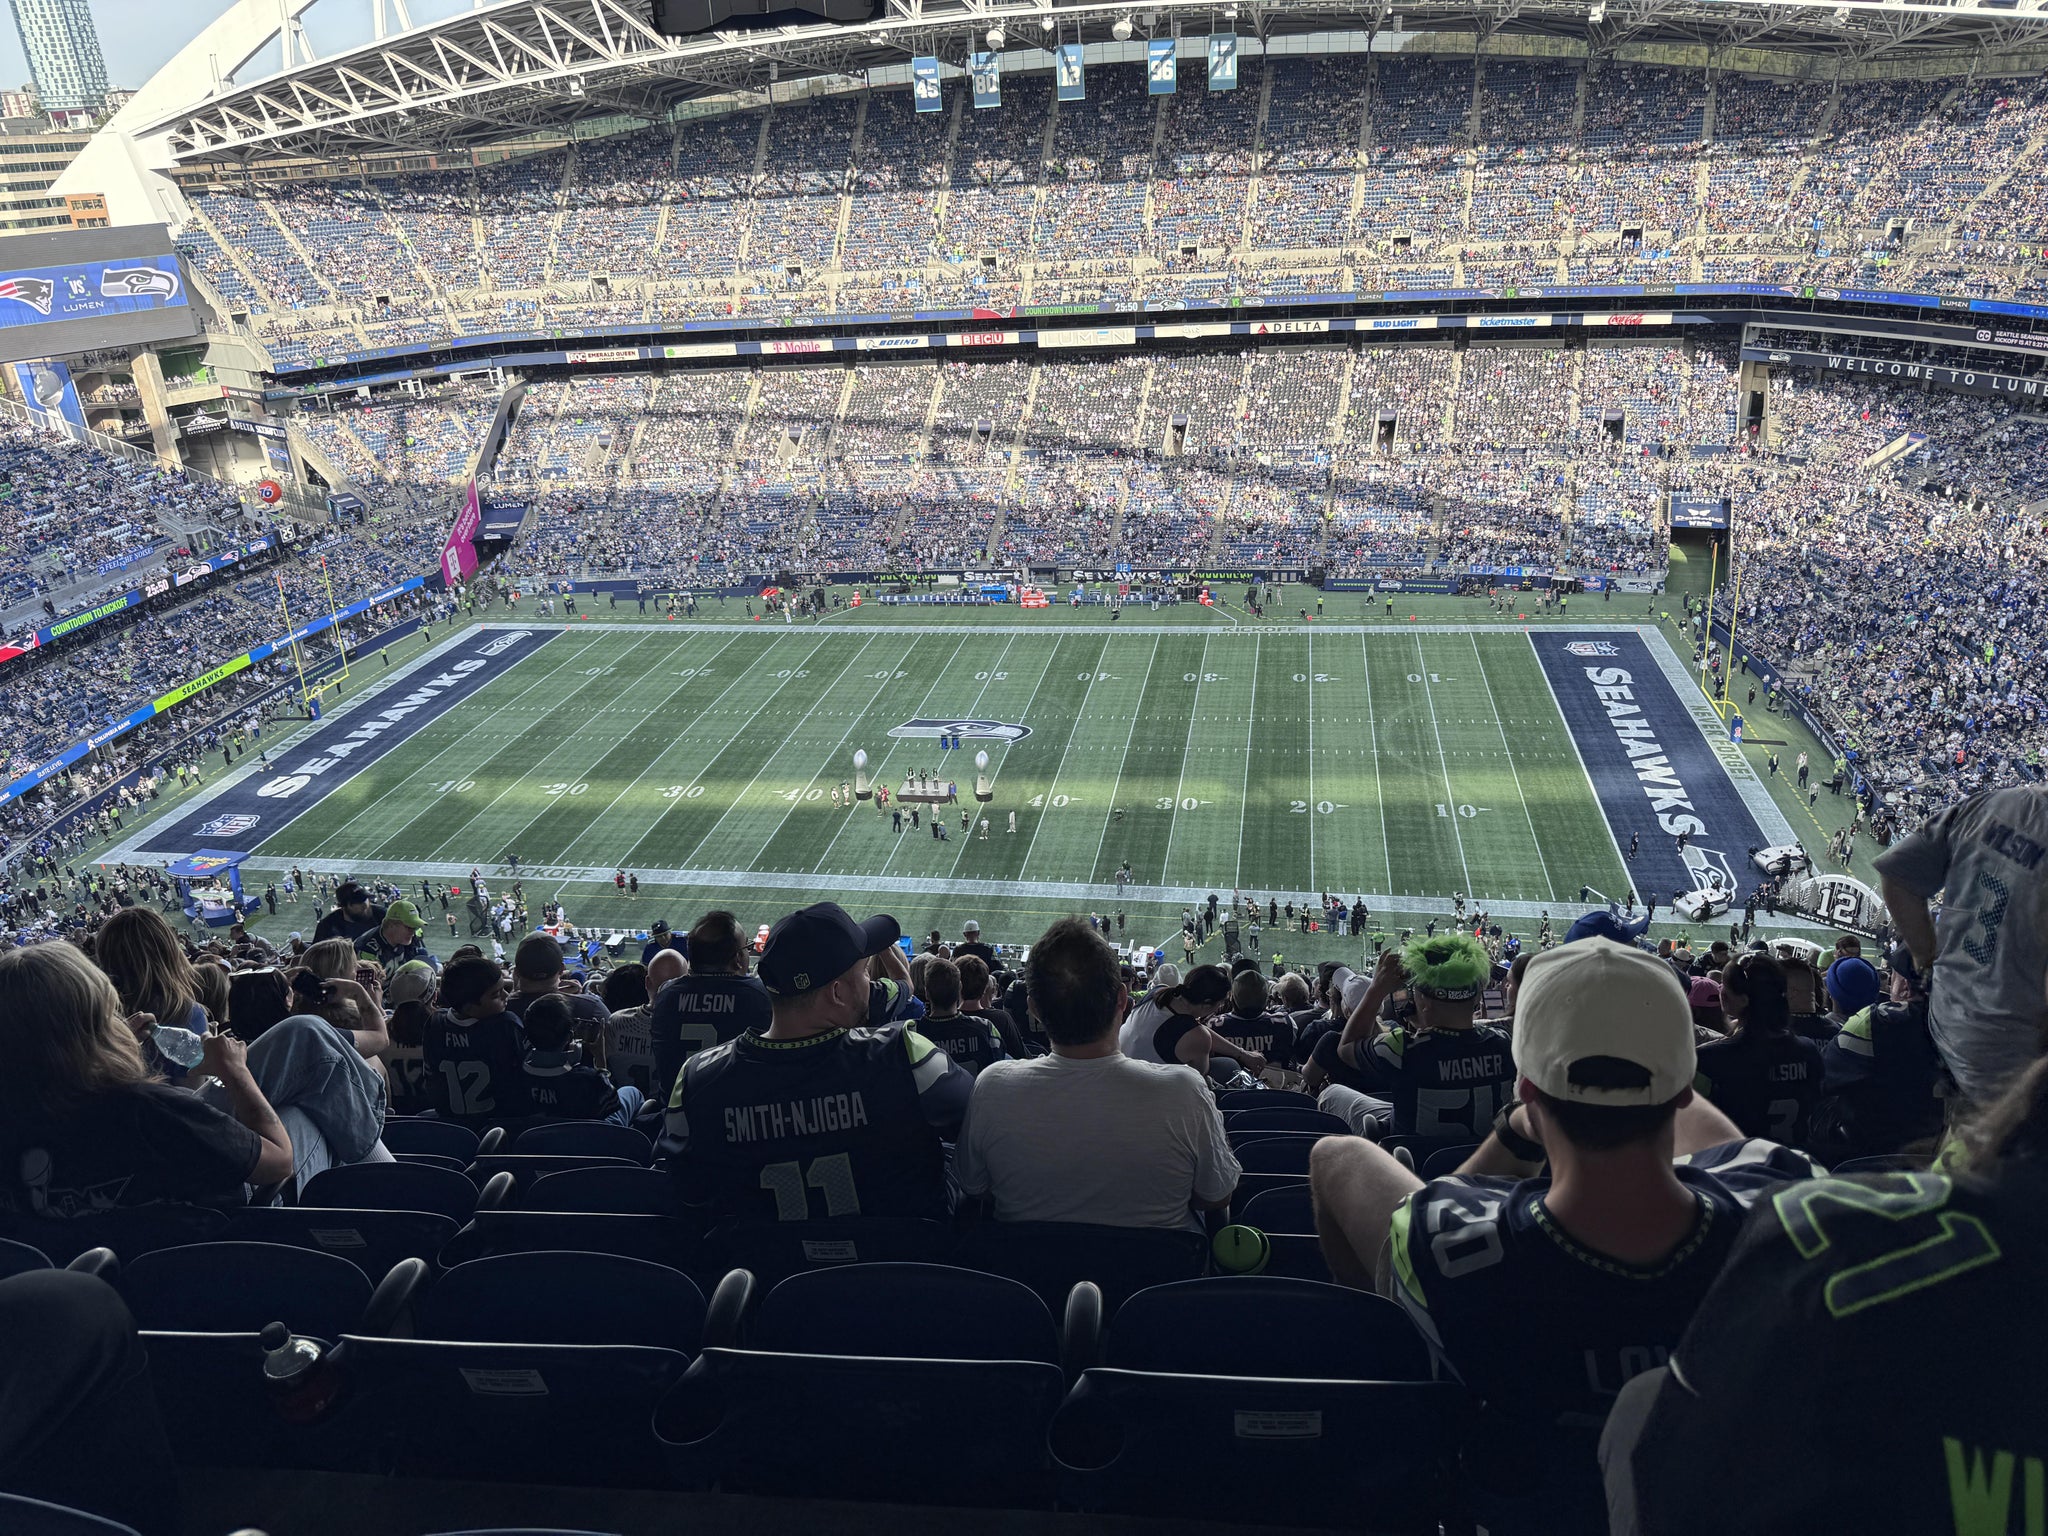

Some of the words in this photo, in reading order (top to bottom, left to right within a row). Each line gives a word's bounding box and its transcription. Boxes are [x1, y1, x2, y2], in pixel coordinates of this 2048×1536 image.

[1061, 66, 1081, 87] 12
[1150, 59, 1174, 81] 96
[916, 78, 939, 99] 45
[975, 73, 999, 95] 80
[69, 280, 85, 295] VS
[1507, 288, 1516, 298] VS
[1804, 287, 1814, 298] VS
[63, 301, 105, 313] LUMEN
[1025, 306, 1062, 315] COUNTDOWN
[1063, 305, 1073, 314] TO
[1074, 304, 1099, 313] KICKOFF
[1115, 302, 1138, 312] 25:50
[1941, 300, 1969, 309] LUMEN
[1273, 322, 1322, 332] DELTA
[1392, 319, 1418, 328] LIGHT
[1480, 316, 1537, 327] ticketmaster
[879, 338, 919, 346] BOEING
[962, 333, 1004, 346] BECU
[1045, 331, 1128, 346] LUMEN
[1978, 331, 1990, 340] CC
[1994, 337, 2018, 345] KICKOFF
[1995, 330, 2020, 339] SEATTLE
[430, 341, 451, 350] LUMEN
[785, 340, 820, 353] Mobile
[1828, 357, 1934, 380] WELCOME
[1950, 371, 1976, 386] TO
[234, 420, 255, 433] DELTA
[259, 487, 272, 498] 76
[282, 527, 294, 540] 25
[318, 537, 342, 551] HYUNDAI
[343, 533, 352, 543] 12
[105, 560, 120, 572] FEEL
[1118, 563, 1129, 572] 12
[1472, 565, 1485, 574] 12
[1508, 566, 1519, 576] 12
[51, 611, 93, 637] COUNTDOWN
[92, 606, 102, 618] TO
[102, 597, 128, 615] KICKOFF
[145, 578, 169, 598] 25:50
[182, 668, 225, 696] SEAHAWKS
[94, 726, 118, 745] COLUMBIA
[118, 719, 131, 732] BANK
[256, 658, 489, 799] SEAHAWKS
[1689, 704, 1726, 737] NEVER
[1711, 738, 1756, 782] FORGET
[1583, 666, 1710, 836] SEAHAWKS
[37, 767, 50, 779] SUITE
[50, 759, 64, 771] LEVEL
[436, 780, 477, 793] 10
[545, 782, 590, 796] 20
[661, 785, 706, 799] 30
[781, 786, 824, 802] 40
[1026, 793, 1070, 808] 40
[1155, 797, 1199, 811] 30
[1289, 800, 1335, 815] 20
[1434, 803, 1479, 818] 10
[492, 865, 597, 879] KICKOFF
[1817, 888, 1858, 924] 12
[1796, 911, 1831, 926] SEATTLE
[1834, 923, 1877, 939] SEAHAWKS
[1963, 871, 2009, 965] 3
[678, 993, 735, 1014] WILSON
[445, 1032, 470, 1048] FAN
[1438, 1054, 1503, 1082] WAGNER
[439, 1060, 496, 1115] 12
[531, 1087, 558, 1104] FAN
[723, 1090, 869, 1143] SMITH-NJIGBA
[759, 1151, 862, 1222] 11
